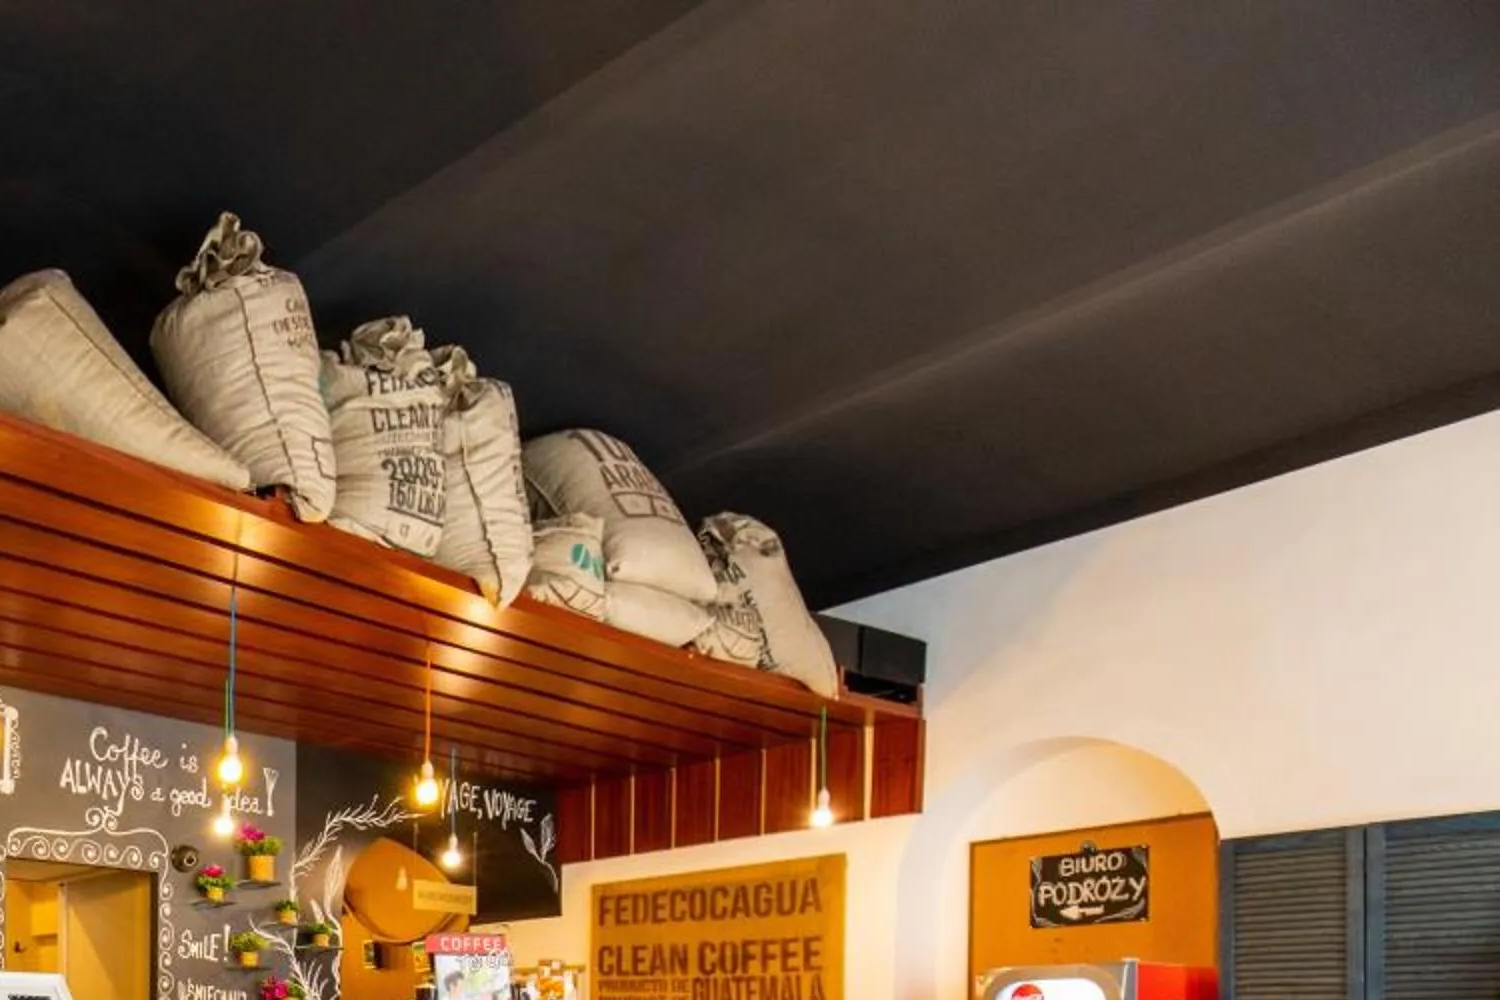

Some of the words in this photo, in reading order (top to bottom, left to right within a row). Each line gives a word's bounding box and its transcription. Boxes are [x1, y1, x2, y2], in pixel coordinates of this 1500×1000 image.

[89, 725, 169, 781] Coffee
[179, 743, 199, 773] is
[59, 757, 145, 816] ALWAYS
[169, 776, 212, 817] good
[483, 788, 537, 831] VOYAGE
[1058, 850, 1125, 877] BIURO
[597, 876, 823, 927] FEDECOCAGUA
[177, 923, 231, 963] SMILE!
[440, 935, 501, 952] COFFEE
[598, 942, 690, 978] CLEAN
[697, 936, 823, 976] COFFEE
